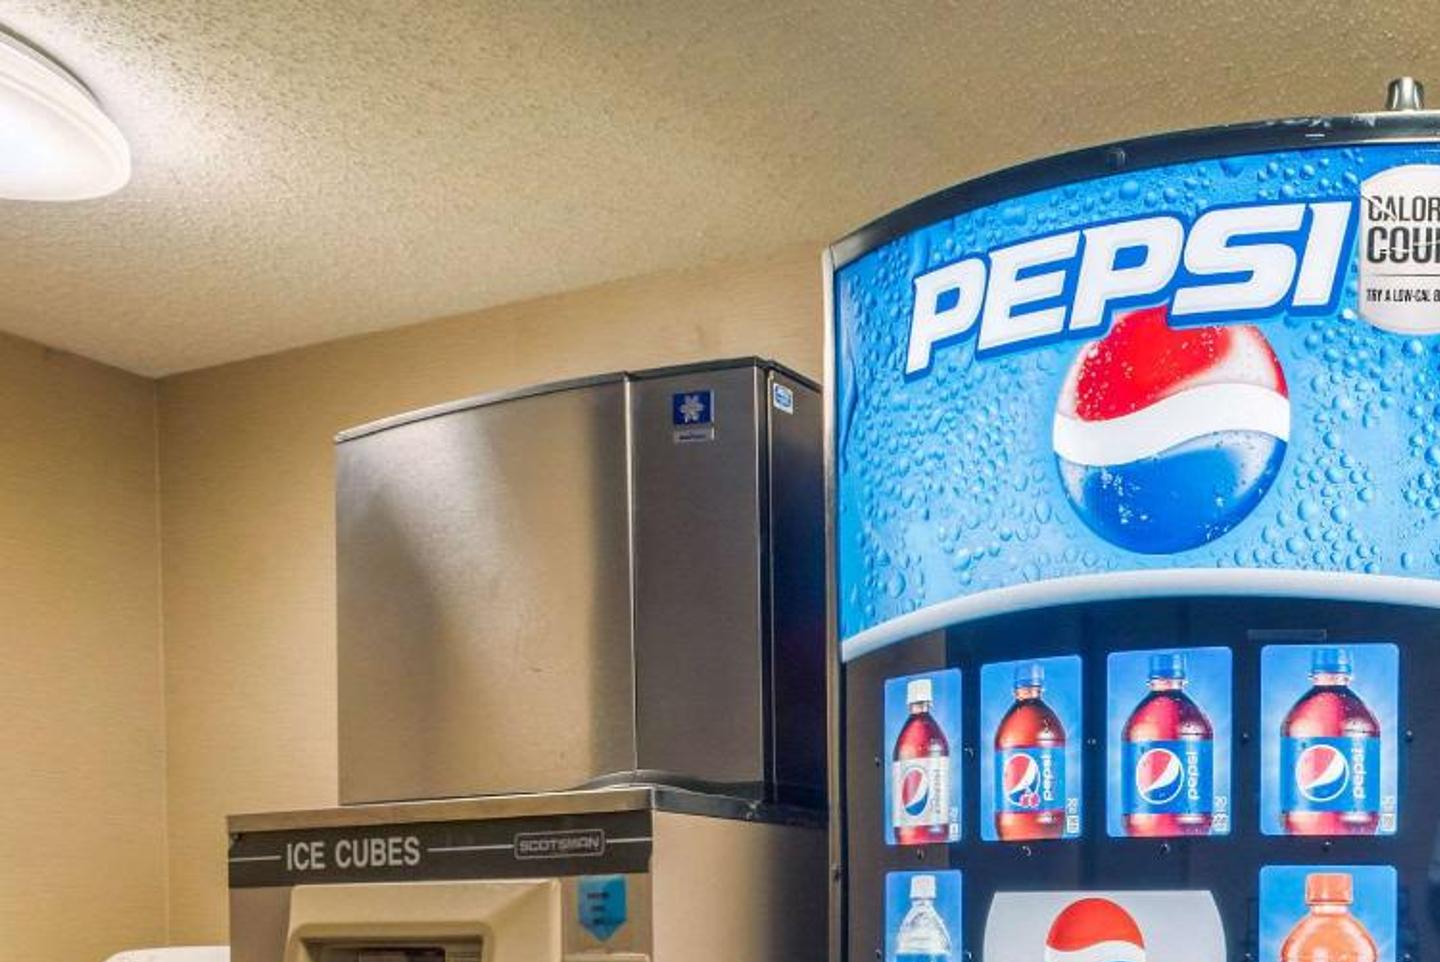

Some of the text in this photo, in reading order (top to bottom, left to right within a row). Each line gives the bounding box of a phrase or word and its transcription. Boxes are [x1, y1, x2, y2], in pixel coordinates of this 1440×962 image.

[906, 200, 1356, 376] PEPSI
[1366, 288, 1382, 303] TRY
[1384, 288, 1392, 302] A
[1042, 751, 1055, 802] pepsi
[1187, 750, 1201, 801] pepsi
[1351, 747, 1366, 800] pepsi
[285, 836, 421, 871] ICE CUBES
[519, 836, 601, 854] SCOTSMAN
